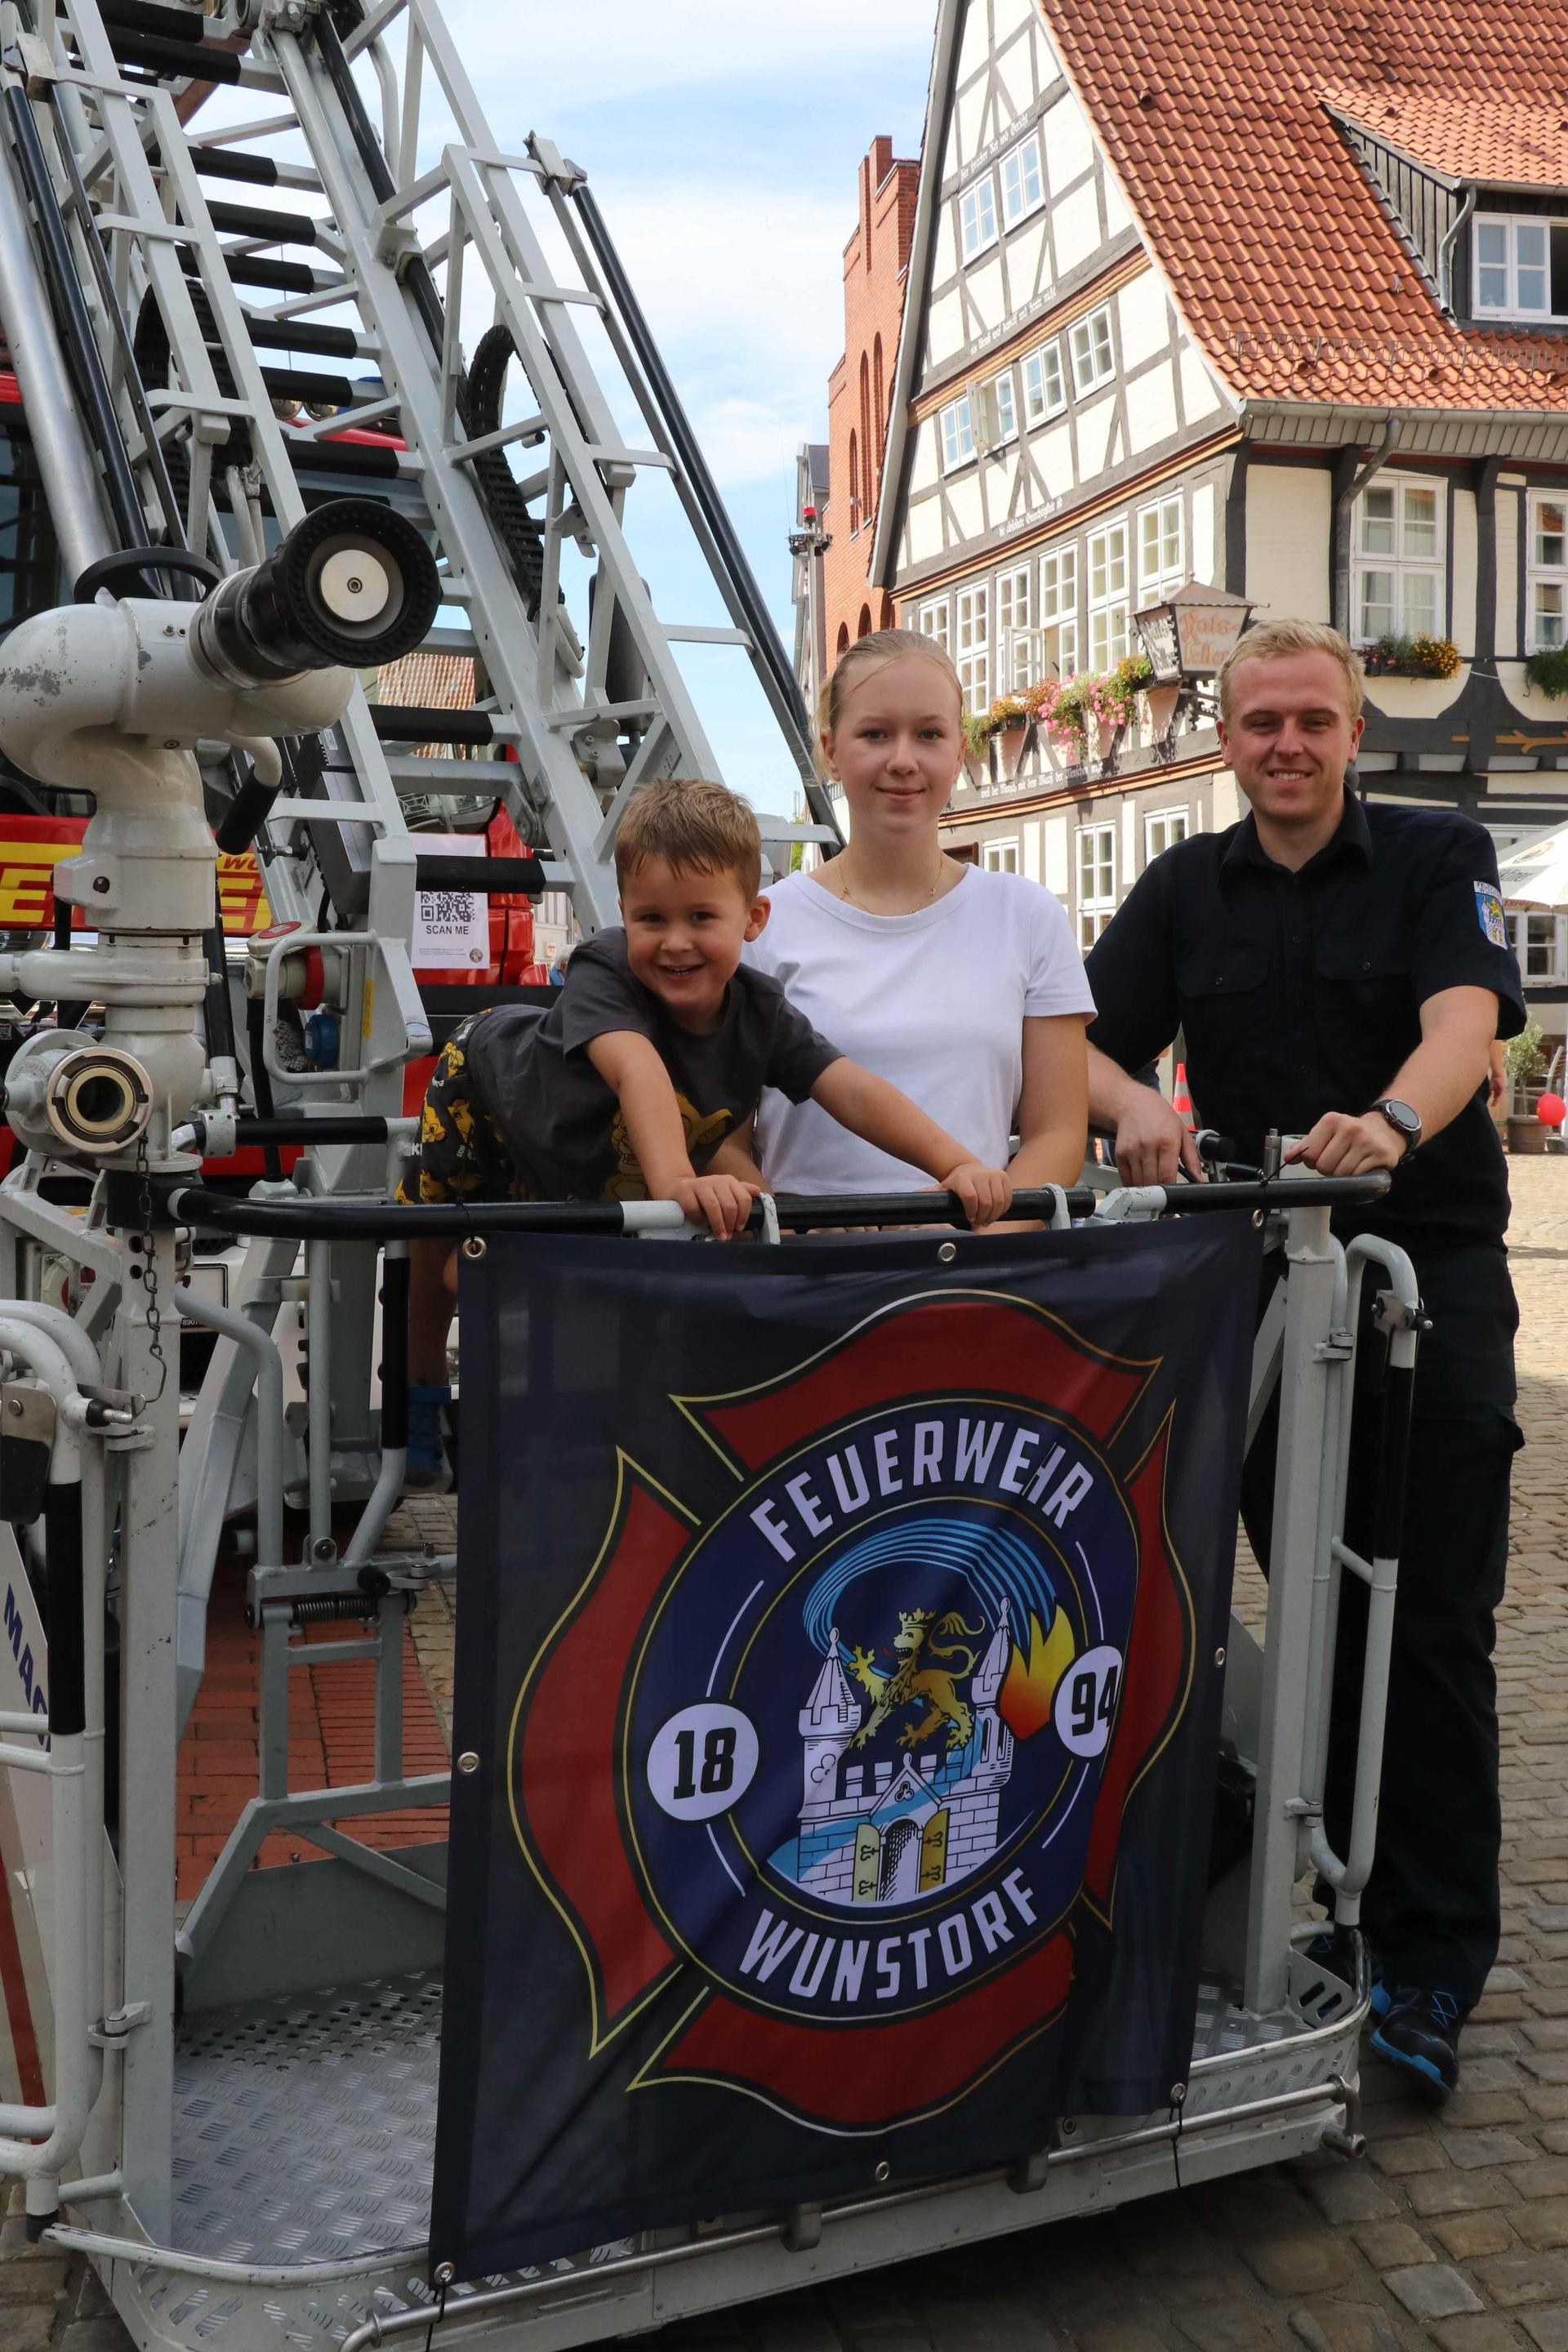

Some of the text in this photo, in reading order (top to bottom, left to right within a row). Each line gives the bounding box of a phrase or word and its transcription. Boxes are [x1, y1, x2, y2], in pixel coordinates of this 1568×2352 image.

[425, 925, 470, 935] SCAN ME
[750, 1417, 1094, 1563] FEUERWEHR
[1071, 1664, 1118, 1738] 94
[672, 1726, 737, 1800] 18
[739, 1867, 1039, 2002] WUNSTORF
